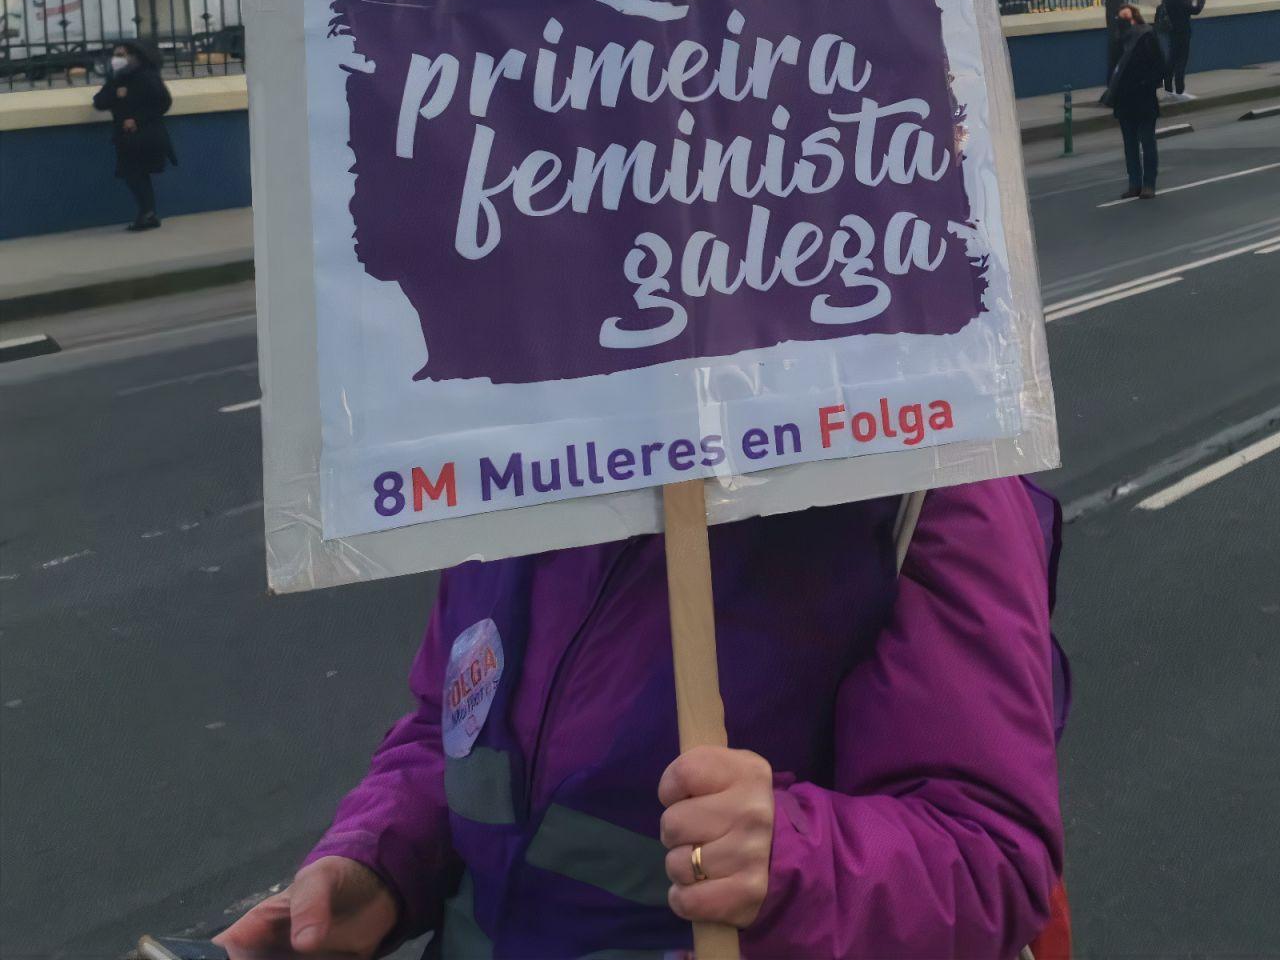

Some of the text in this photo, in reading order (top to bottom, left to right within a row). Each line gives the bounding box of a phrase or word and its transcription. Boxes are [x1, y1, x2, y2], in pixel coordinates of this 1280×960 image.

[396, 10, 872, 159] primeira
[455, 97, 951, 261] feminista
[599, 204, 947, 349] galega
[373, 397, 954, 517] 8M Mulleres en Folga
